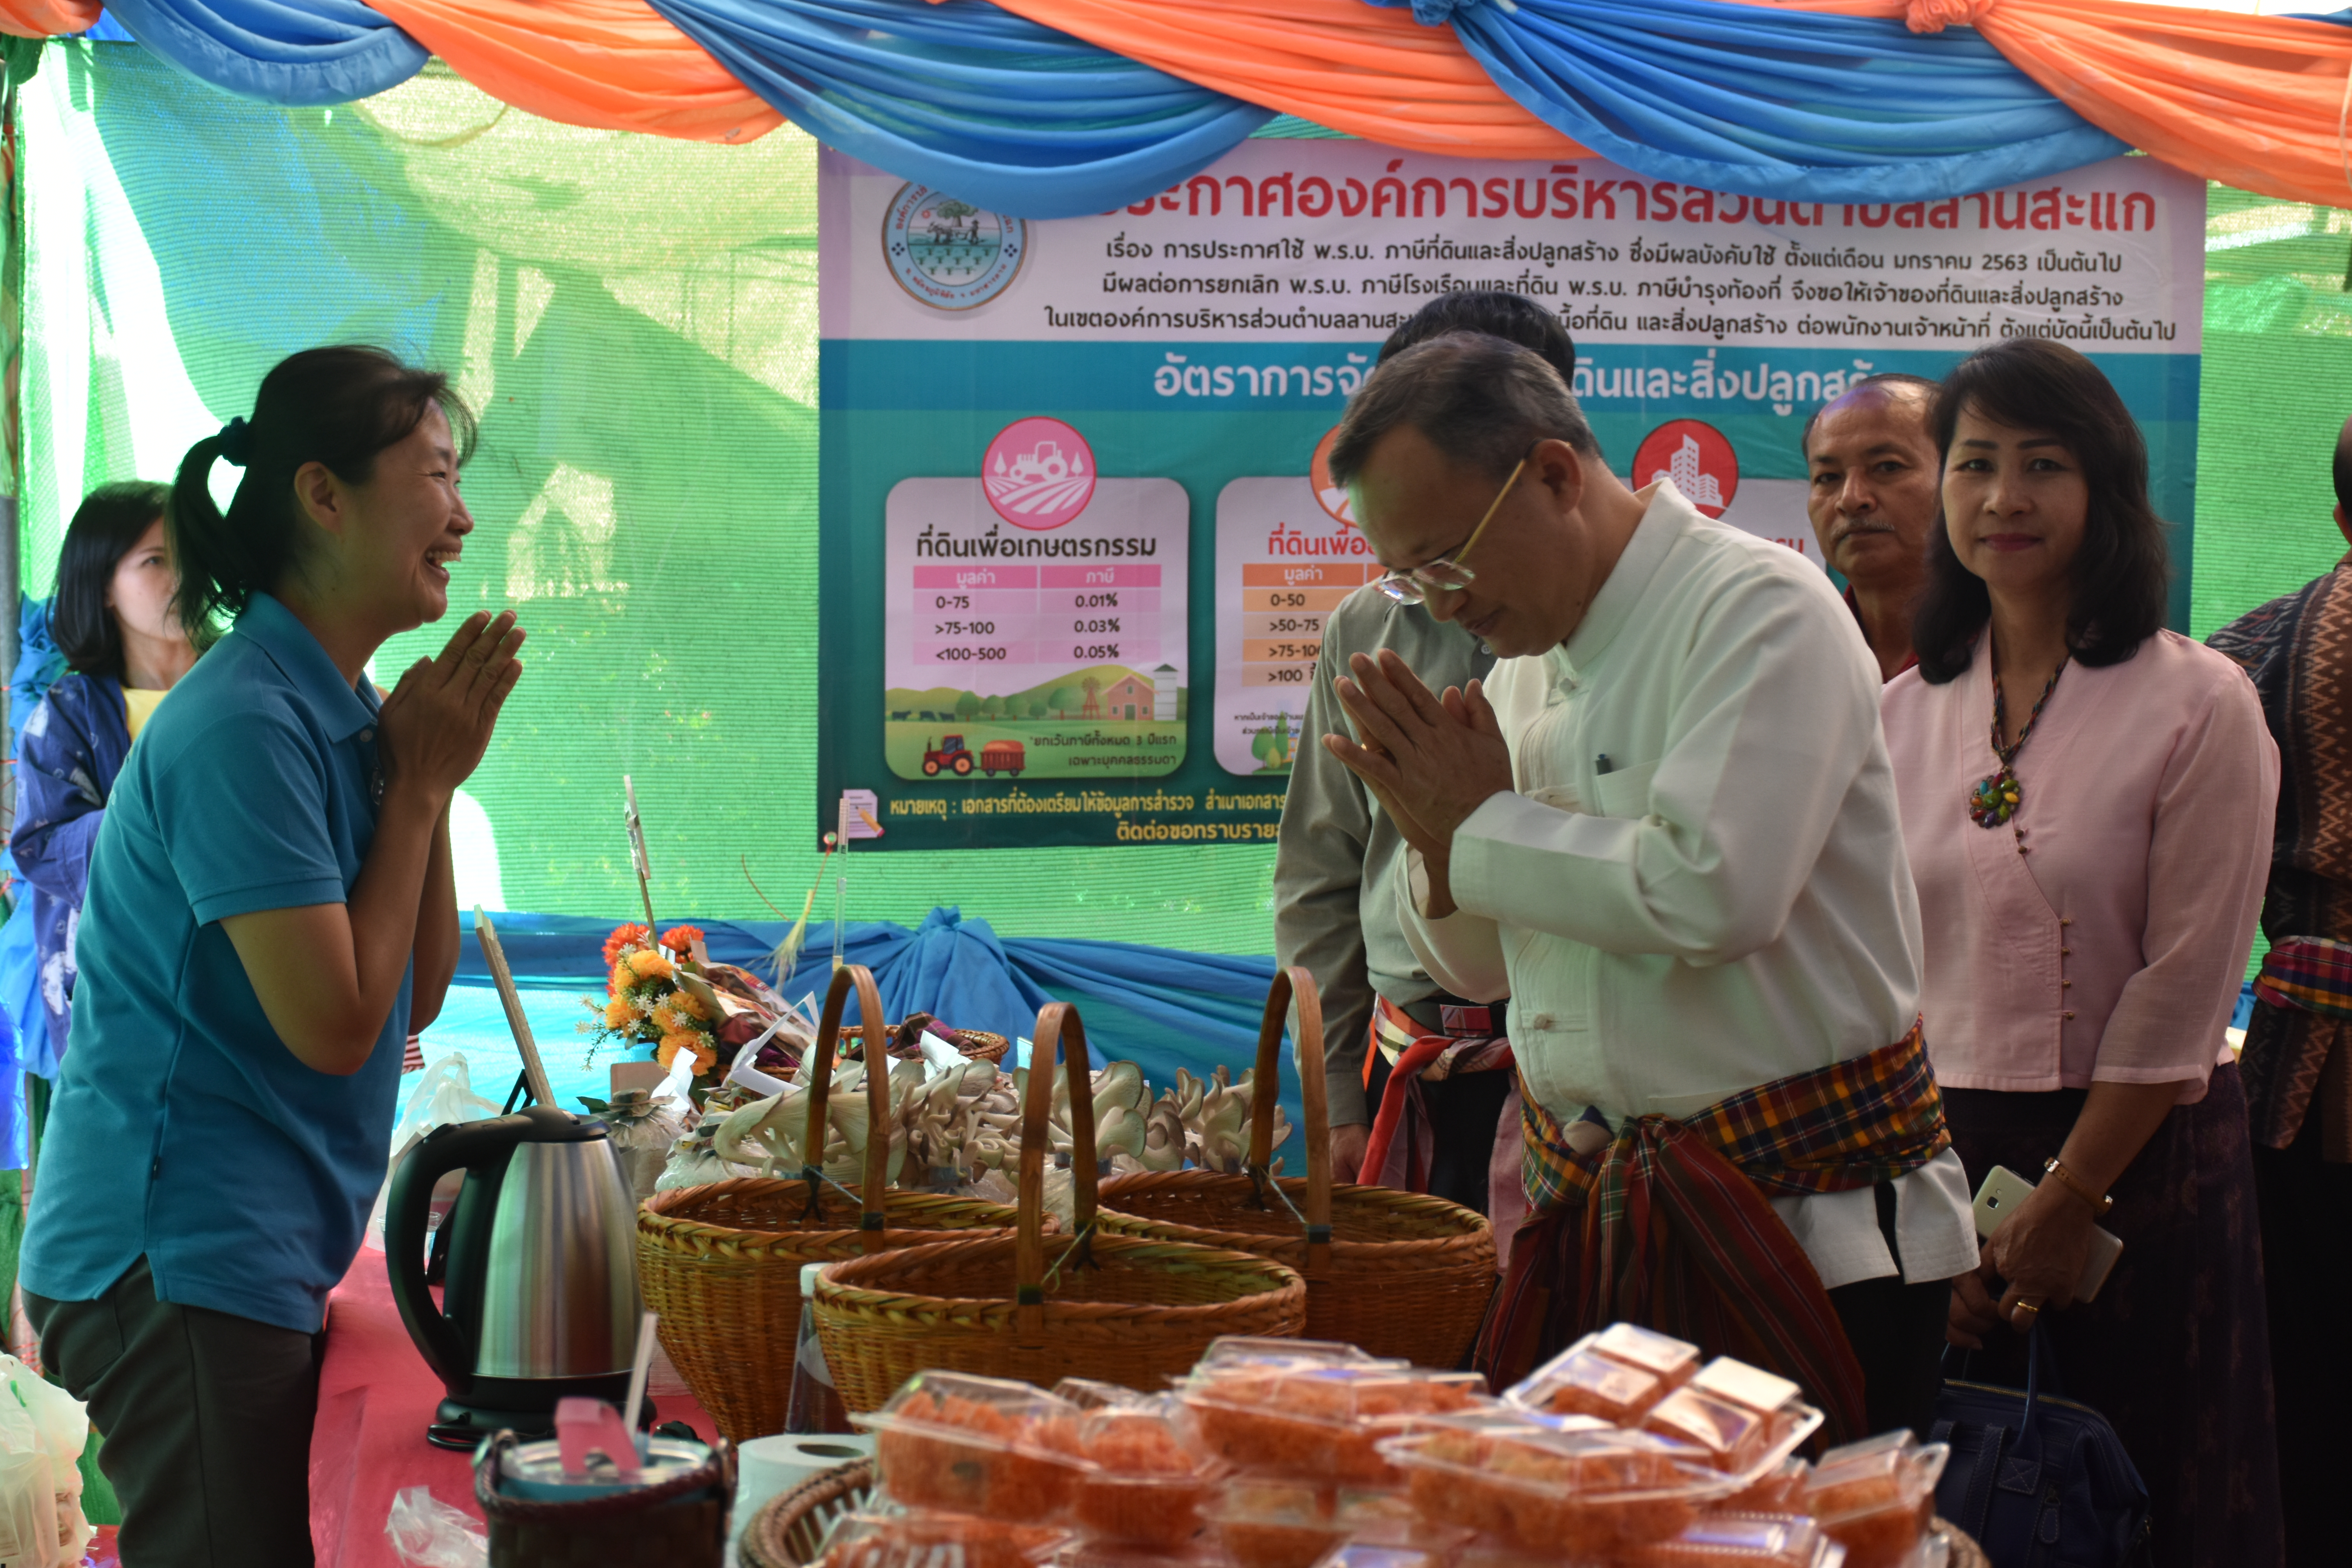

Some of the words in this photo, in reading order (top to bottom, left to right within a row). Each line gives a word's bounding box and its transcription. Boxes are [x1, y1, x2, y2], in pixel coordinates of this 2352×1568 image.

[1107, 231, 1153, 258] เรื่อง
[1163, 238, 1305, 259] การประกาศใช้
[1314, 244, 1374, 260] พ.ร.บ.
[1385, 233, 1619, 267] ภาษีที่ดินและสิ่งปลูกสร้าง
[1630, 236, 1777, 266] ซึ่งมีผลบังคับใช้
[1784, 240, 1884, 269] ตั้งแต่เดือน
[1894, 254, 1972, 270] มกราคม
[1982, 254, 2027, 271] 2563
[2037, 249, 2122, 273] เป็นต้นไป
[1103, 271, 1279, 294] มีผลต่อการยกเลิก
[1289, 279, 1350, 294] พ.ร.บ.
[1568, 281, 1626, 296] พ.ร.บ.
[1637, 274, 1782, 306] ภาษีบำรุงท้องที่
[1791, 277, 2123, 312] จึงขอให้เจ้าของที่ดินและสิ่งปลูกสร้าง
[1637, 307, 1787, 341] และสิ่งปลูกสร้าง
[1797, 312, 1991, 338] ต่อพนักงานเจ้าหน้าที่
[917, 524, 1156, 557] ที่ดินเพื่อเกษตรกรรม
[1268, 522, 1375, 556] ที่ดินเพื่อ
[956, 568, 996, 589] มูลค่า
[1284, 565, 1323, 586] มูลค่า
[936, 595, 970, 609] 0-75
[1075, 592, 1118, 608] 0.01%
[1270, 593, 1305, 607] 0-50
[935, 621, 995, 635] >75-100
[1074, 618, 1120, 633] 0.03%
[1270, 618, 1319, 632] >50-75
[936, 647, 1007, 661] <100-500
[1073, 644, 1119, 659] 0.05%
[1269, 669, 1303, 682] >100
[890, 799, 947, 820] หมายเหตุ
